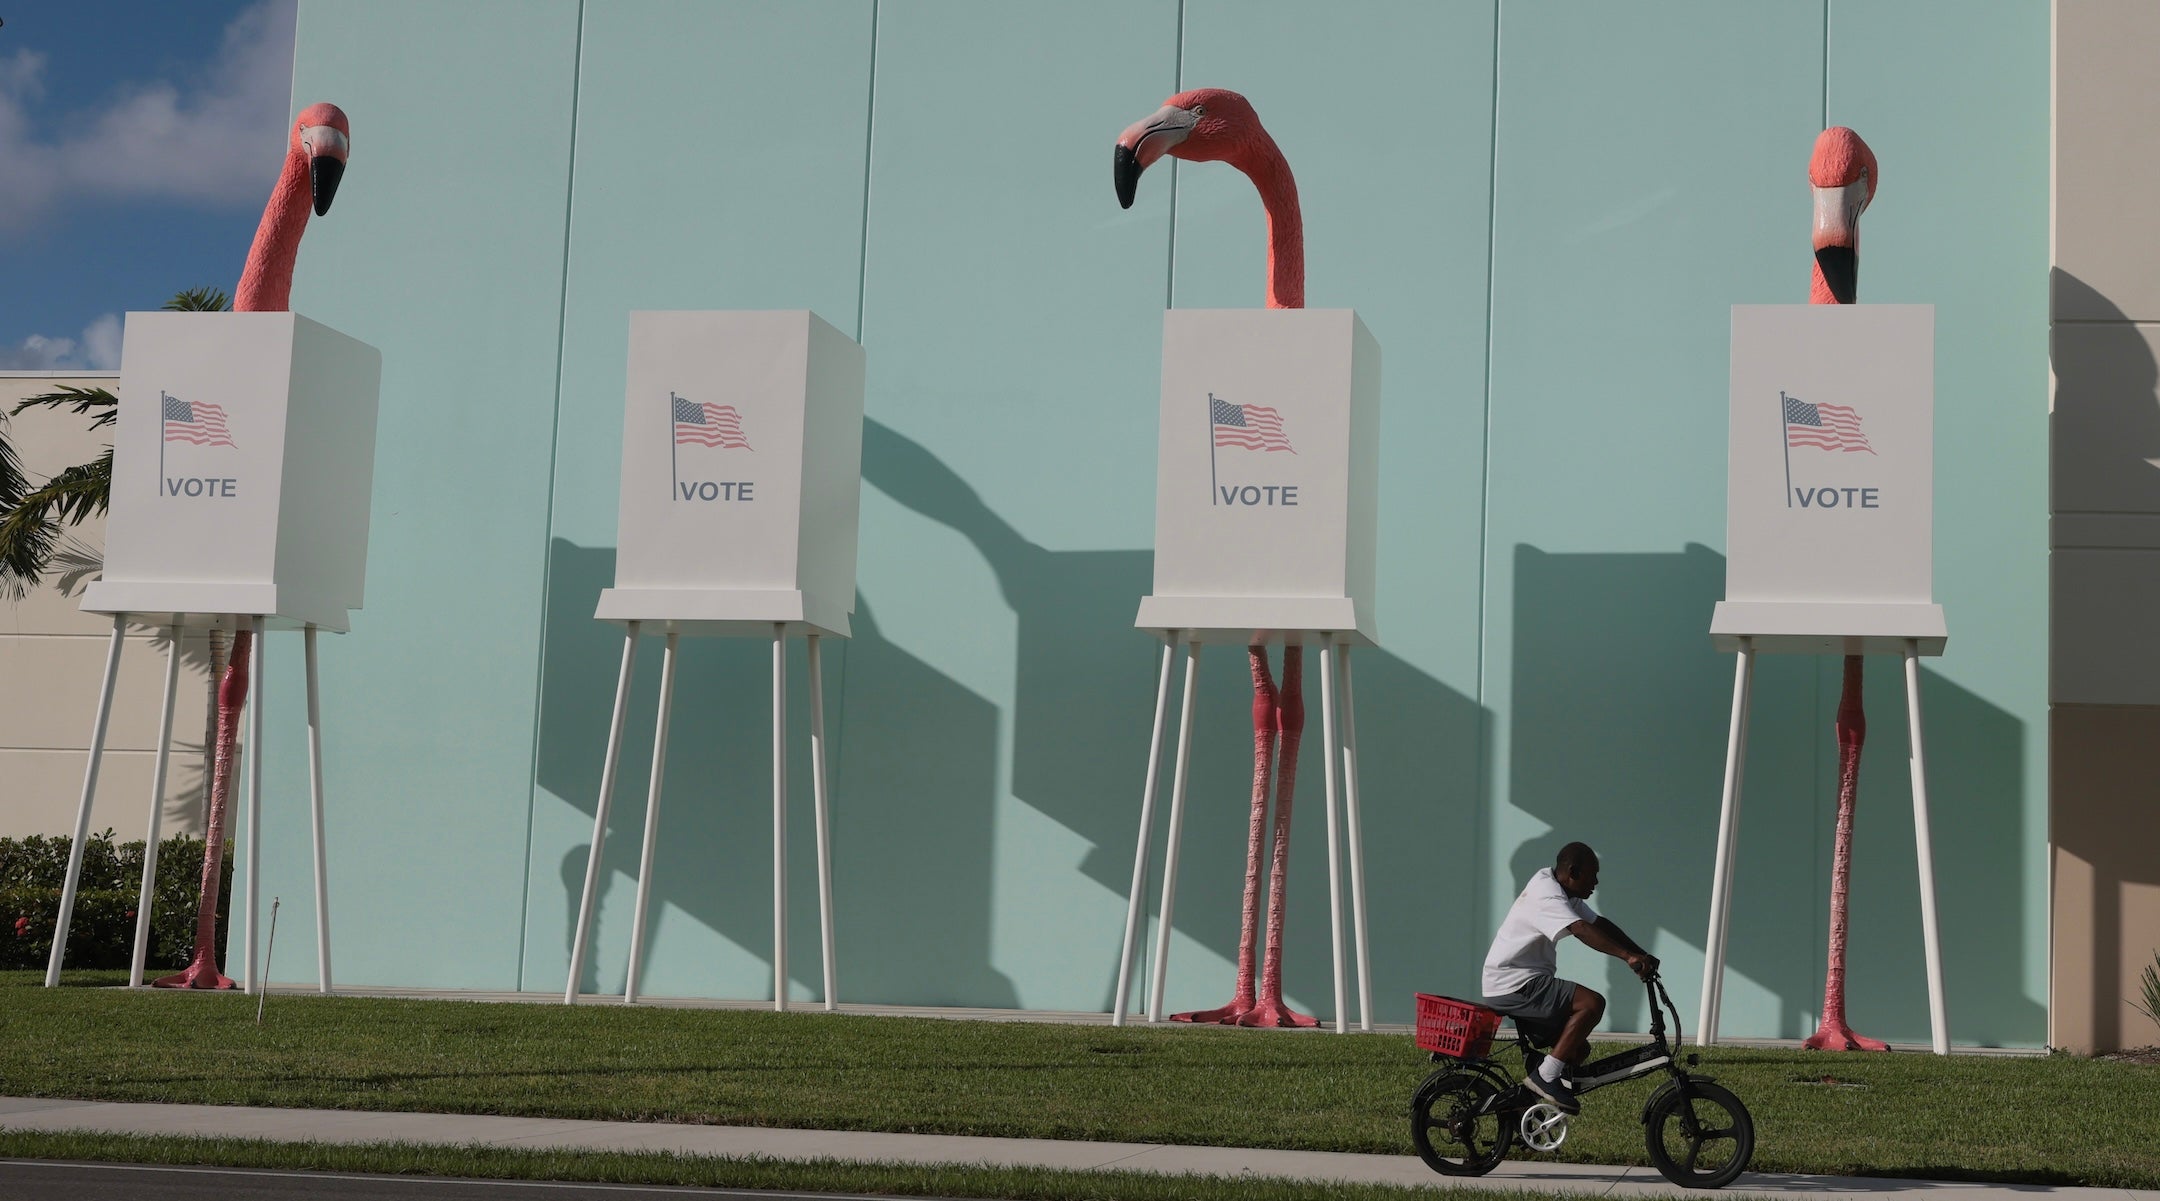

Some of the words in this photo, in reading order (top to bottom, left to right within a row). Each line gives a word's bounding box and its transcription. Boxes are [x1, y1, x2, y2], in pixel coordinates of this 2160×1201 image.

[167, 478, 236, 497] VOTE
[680, 482, 753, 501] VOTE
[1220, 486, 1298, 505] VOTE
[1795, 488, 1879, 508] VOTE
